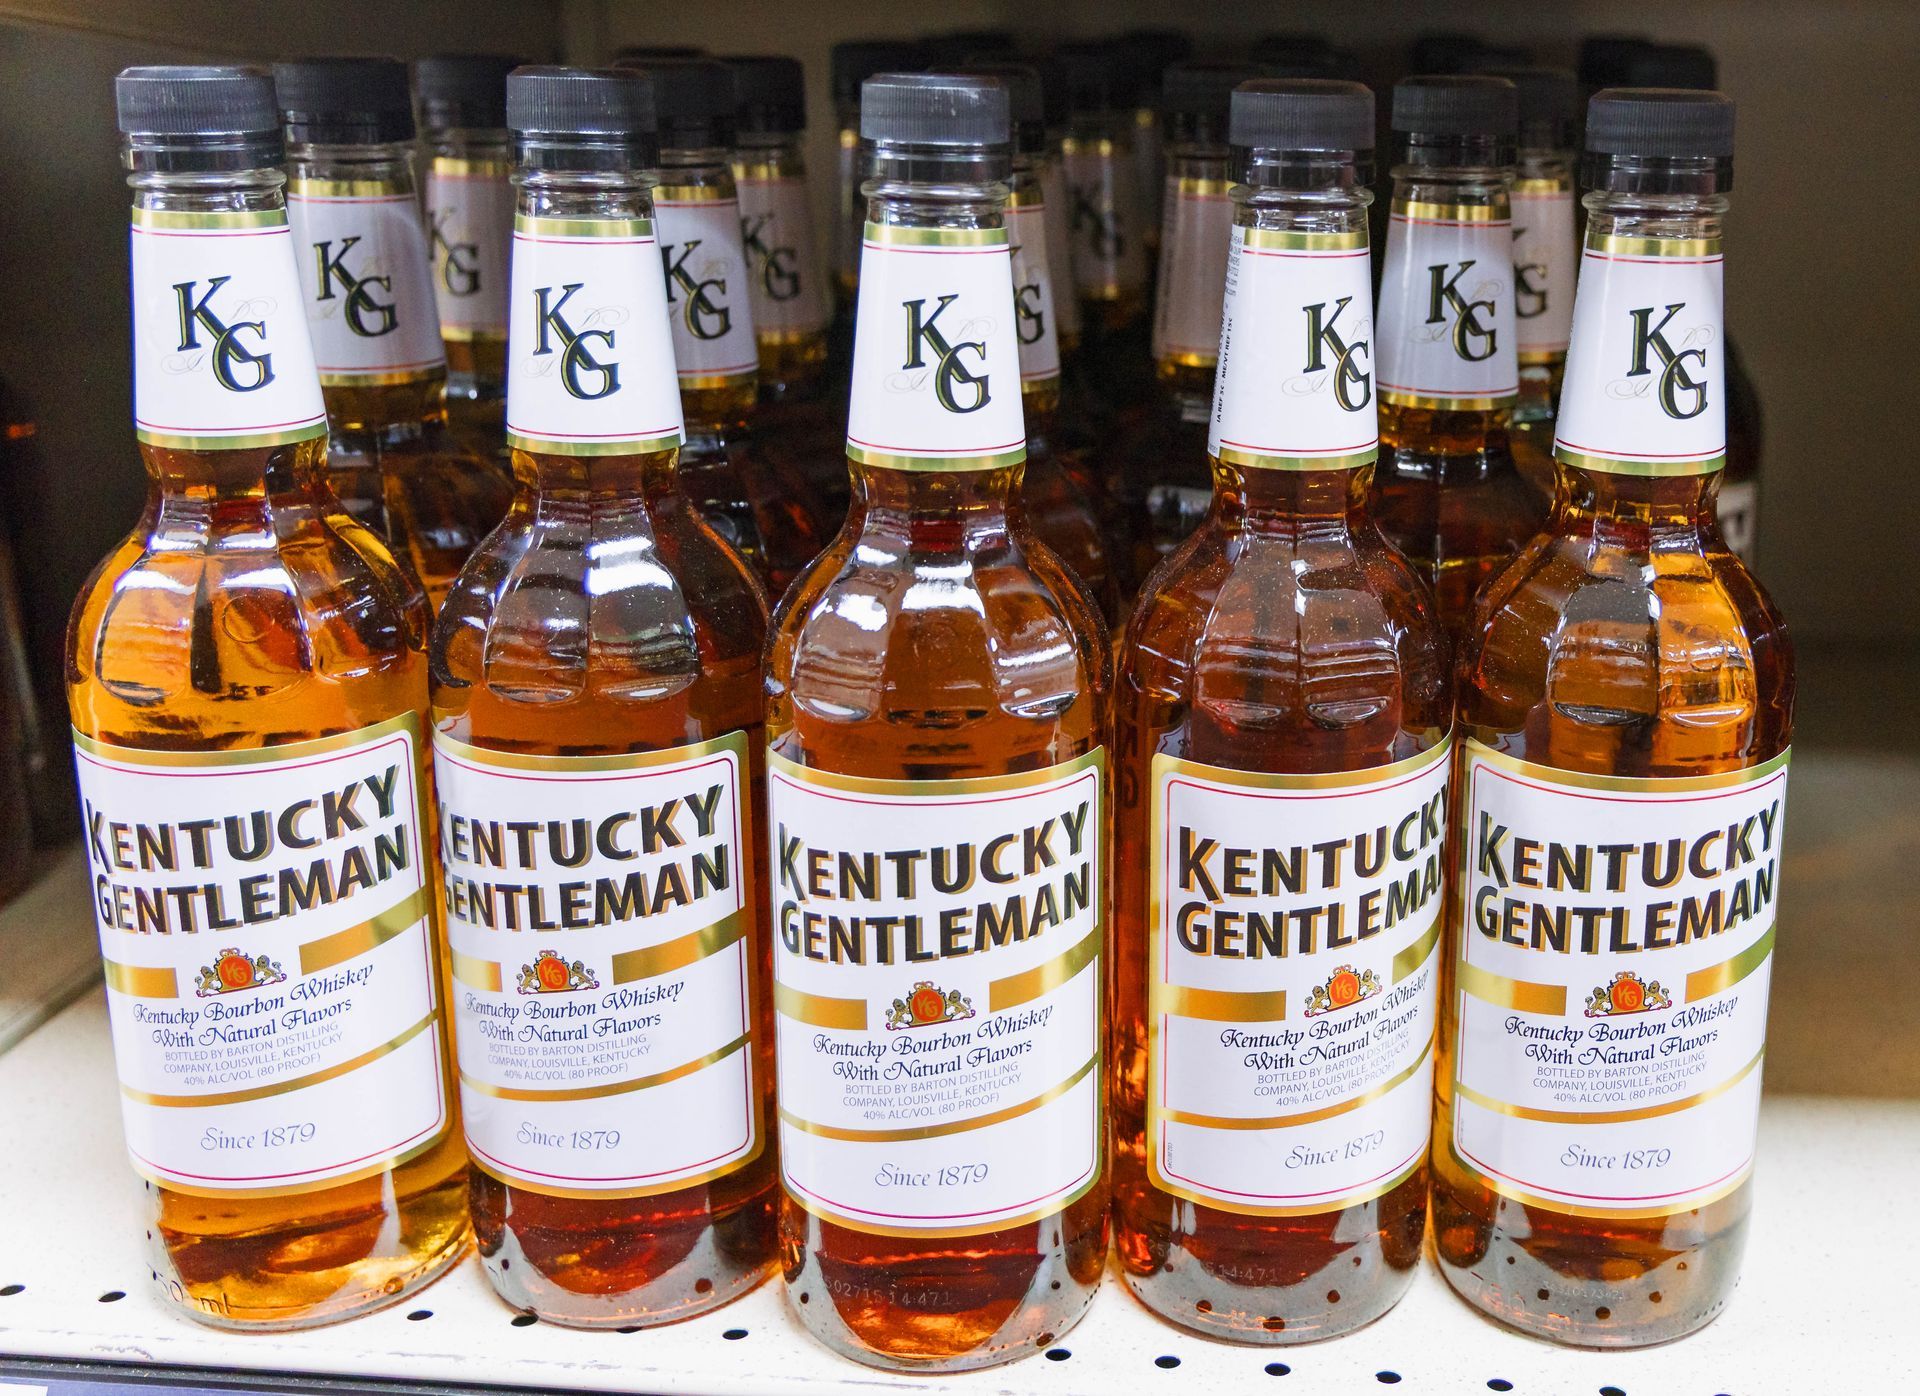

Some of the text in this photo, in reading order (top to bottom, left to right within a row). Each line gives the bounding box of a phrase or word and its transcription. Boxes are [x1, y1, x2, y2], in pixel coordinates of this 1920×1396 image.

[313, 236, 398, 337] KG
[1425, 259, 1497, 362] KG
[172, 275, 275, 392] KG
[533, 282, 622, 400] KG
[902, 293, 991, 414] KG
[1302, 295, 1371, 413] KG
[1626, 302, 1708, 420] KG
[85, 764, 401, 874] KENTUCKY
[778, 800, 1090, 905] KENTUCKY
[1479, 798, 1780, 893] KENTUCKY
[98, 823, 410, 935] GENTLEMAN
[780, 861, 1090, 966] GENTLEMAN
[1475, 858, 1775, 955] GENTLEMAN
[133, 963, 373, 1029] Kentucky Bourbon Whiskey
[465, 981, 684, 1024] Kentucky Bourbon Whiskey
[152, 998, 351, 1048] With Natural Flavors
[165, 1022, 338, 1061] BOTTLED BY BARTON DISTILLING
[479, 1014, 661, 1043] With Natural Flavors
[813, 1004, 1053, 1063] Kentucky Bourbon Whiskey
[1220, 1029, 1304, 1051] Kentucky
[1309, 1008, 1377, 1040] Bourbon
[1244, 1005, 1418, 1070] With Natural Flavors
[1505, 996, 1737, 1048] Kentucky Bourbon Whiskey
[283, 1033, 343, 1057] KENTUCKY
[489, 1034, 647, 1056] BOTTLED BY BARTON DISTILLING
[593, 1044, 650, 1065] KENTUCKY
[833, 1040, 1032, 1081] With Natural Flavors
[1525, 1029, 1718, 1065] With Natural Flavors
[1537, 1051, 1705, 1079] BOTTLED BY BARTON DISTILLING
[184, 1054, 321, 1086] 40% ALC/VOL (80 PROOF)
[504, 1063, 628, 1080] 40% ALC/VOL (80 PROOF)
[846, 1062, 1018, 1094] BOTTLED BY BARTON DISTILLING
[965, 1073, 1022, 1096] KENTUCKY
[1258, 1071, 1306, 1083] BOTTLED
[1309, 1067, 1321, 1080] BY
[1324, 1053, 1365, 1075] BARTON
[1655, 1062, 1707, 1084] KENTUCKY
[863, 1093, 1000, 1120] 40% ALC/VOL (80 PROOF)
[1276, 1095, 1299, 1106] 40%
[1302, 1085, 1346, 1103] ALC/VOL
[1553, 1081, 1687, 1103] 40% ALC/VOL (80 PROOF)
[200, 1123, 315, 1150] Since 1879
[517, 1121, 620, 1150] Since 1879
[1285, 1130, 1384, 1169] Since 1879
[875, 1163, 988, 1187] Since 1879
[1560, 1144, 1671, 1170] Since 1879
